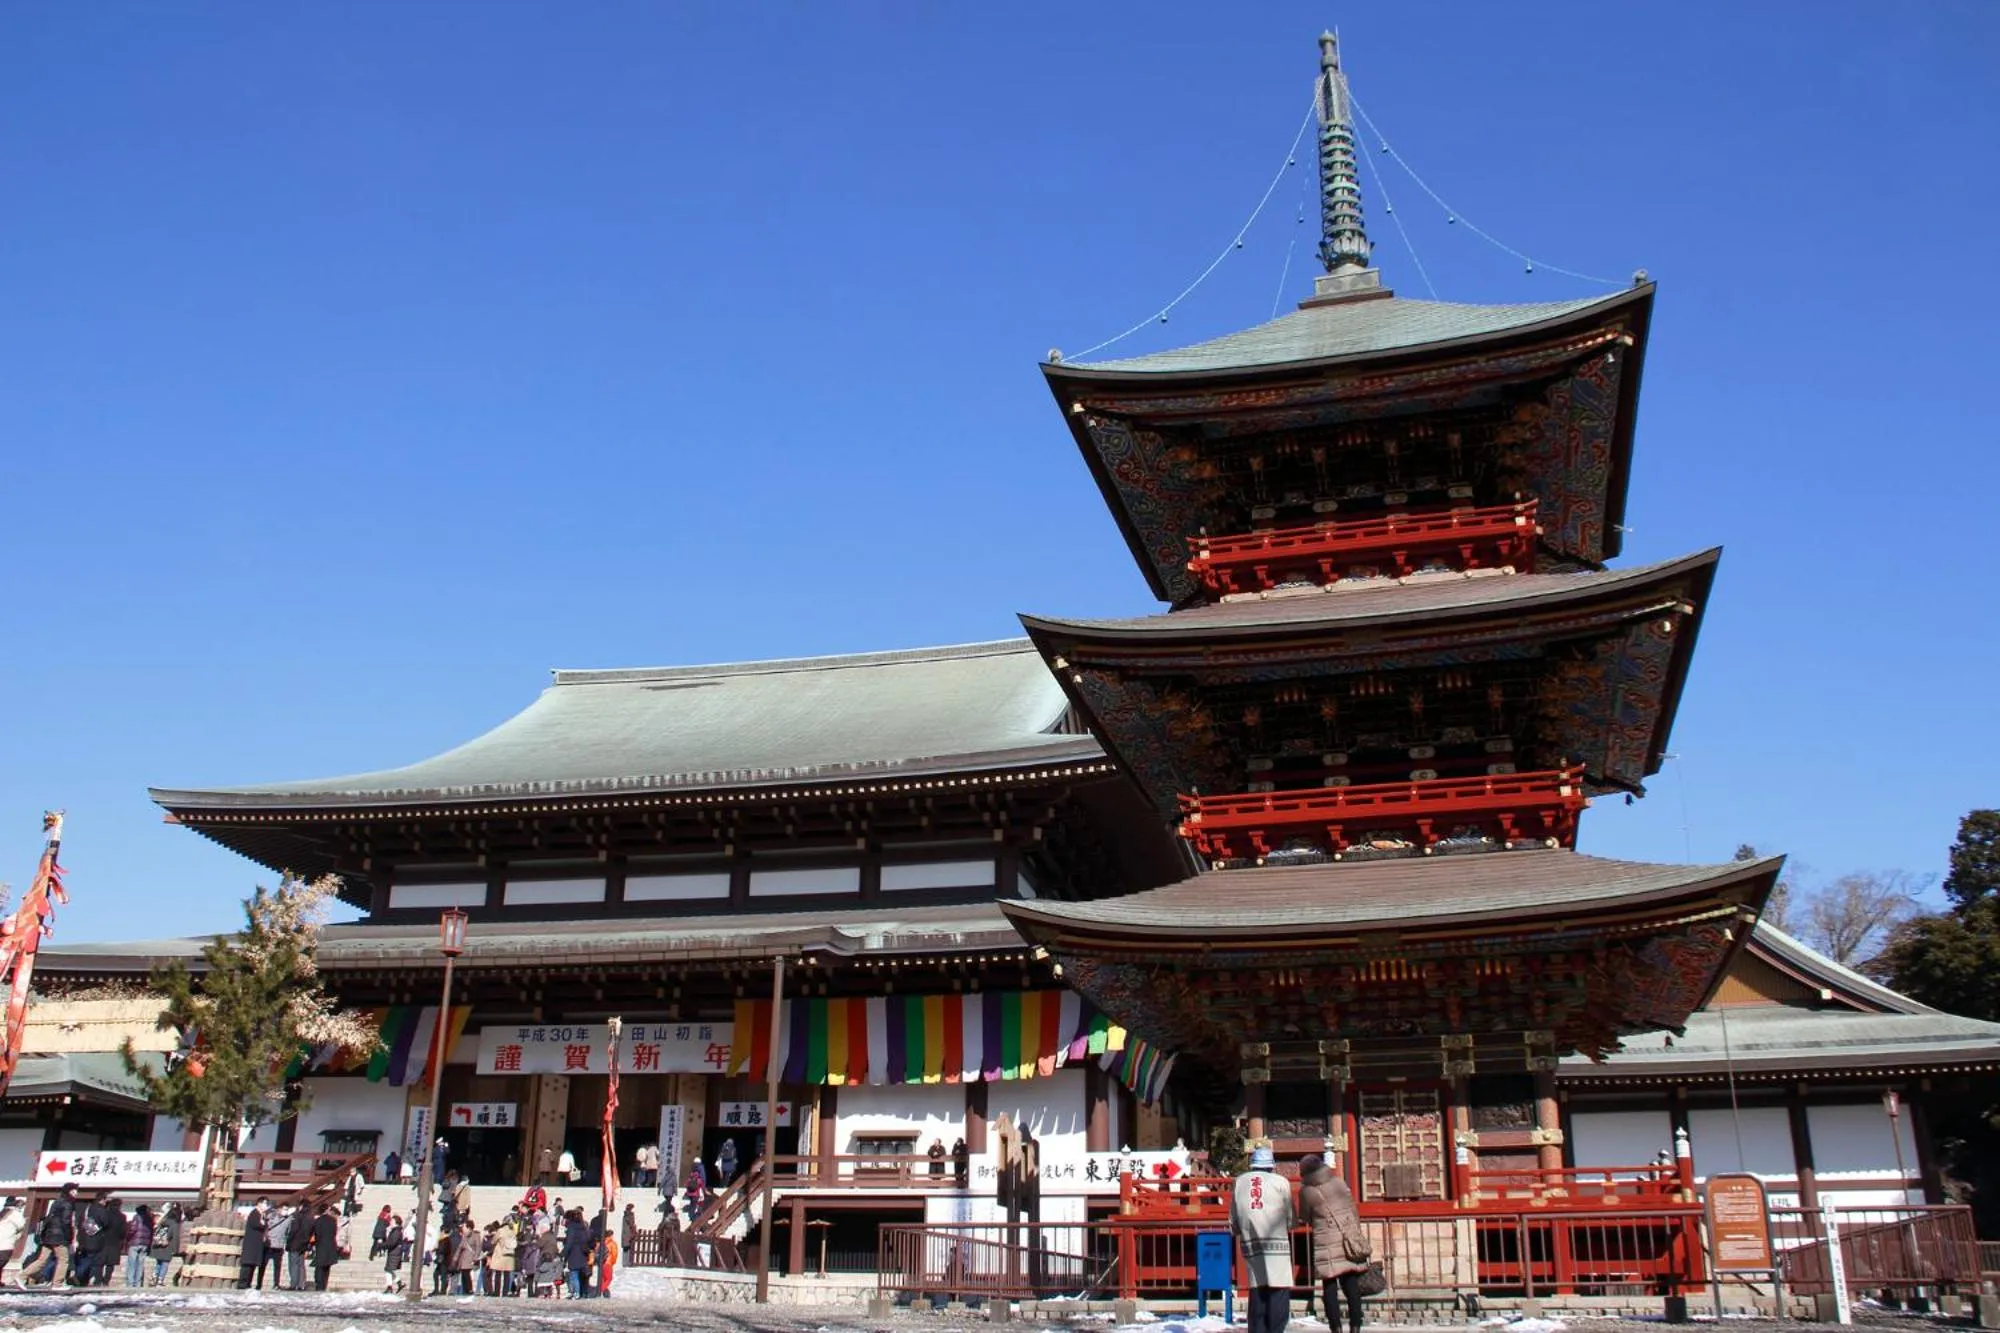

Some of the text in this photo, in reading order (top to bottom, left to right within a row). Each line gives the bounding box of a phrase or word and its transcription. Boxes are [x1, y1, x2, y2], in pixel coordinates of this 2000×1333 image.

[518, 1027, 713, 1042] 平成30年 田山初詣
[494, 1044, 732, 1072] 謹賀新年
[477, 1112, 509, 1125] 順路
[725, 1111, 763, 1125] 順路
